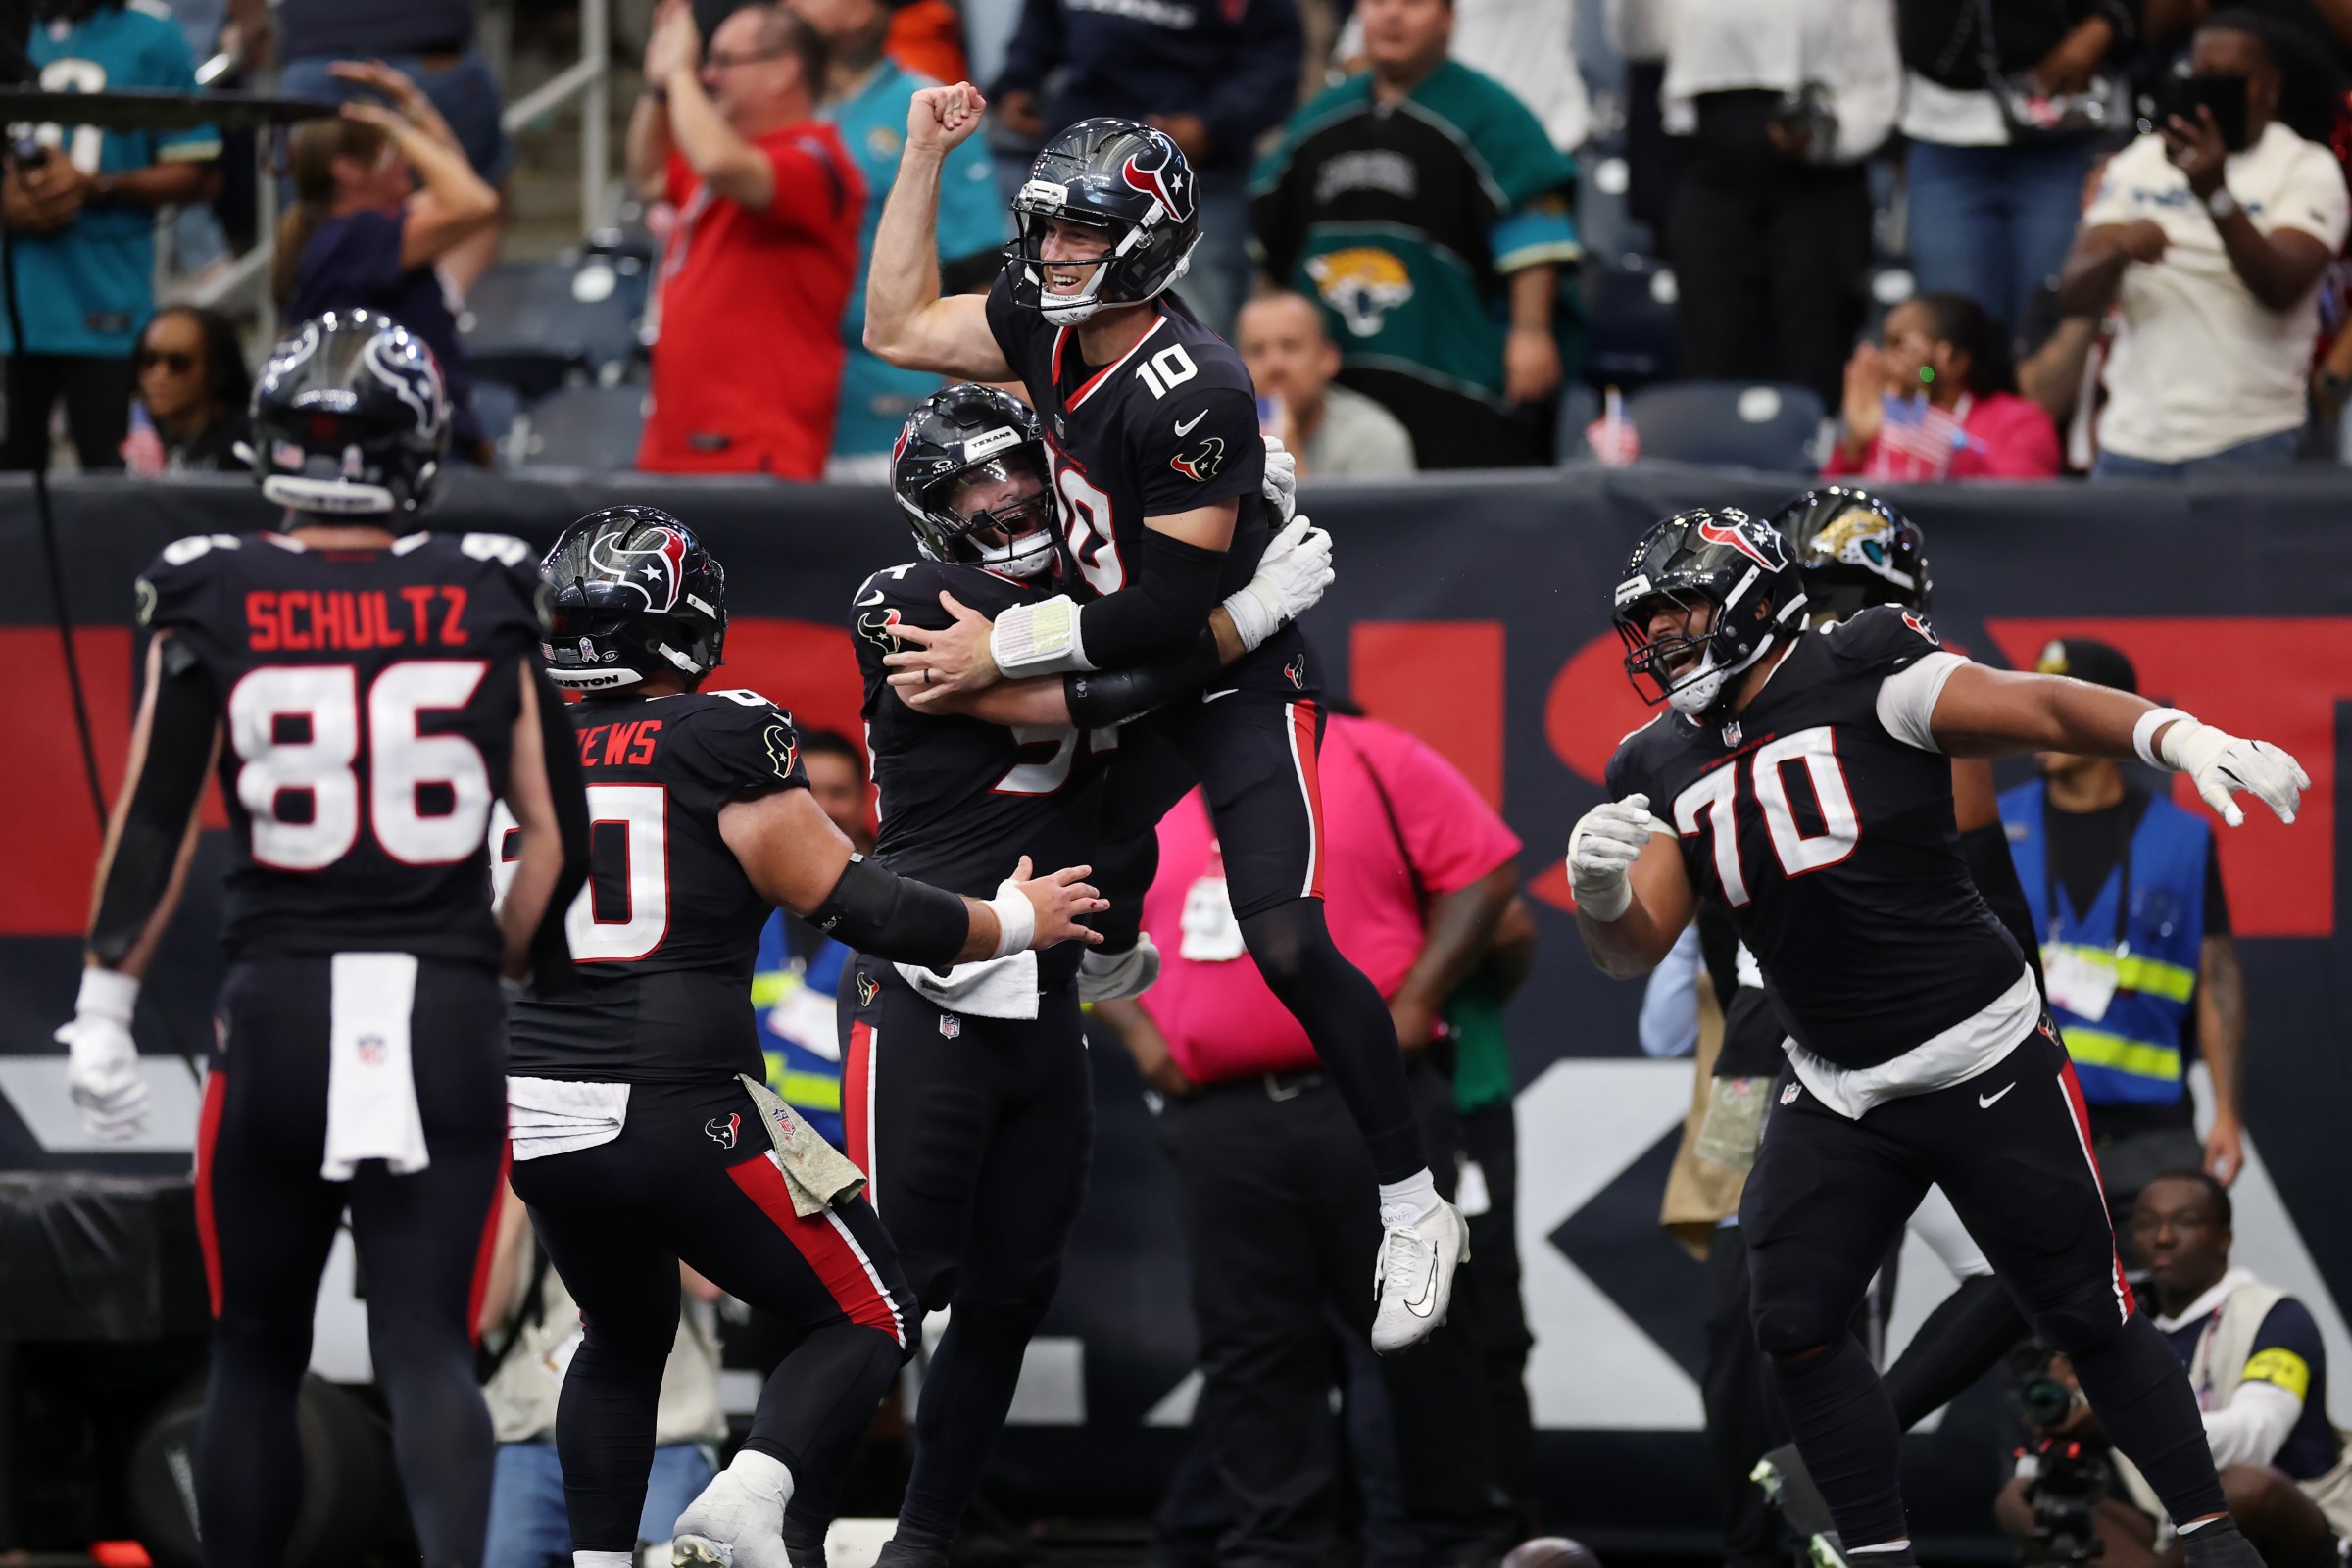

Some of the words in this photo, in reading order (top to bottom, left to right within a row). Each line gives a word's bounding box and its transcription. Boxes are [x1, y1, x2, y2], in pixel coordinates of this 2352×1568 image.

[1135, 343, 1198, 400] 10
[971, 430, 1012, 449] TEXANS
[932, 464, 957, 475] OAKLEY
[246, 585, 470, 652] SCHULTZ
[227, 659, 492, 872] 86
[574, 720, 663, 767] EWS
[1673, 725, 1863, 909] 70
